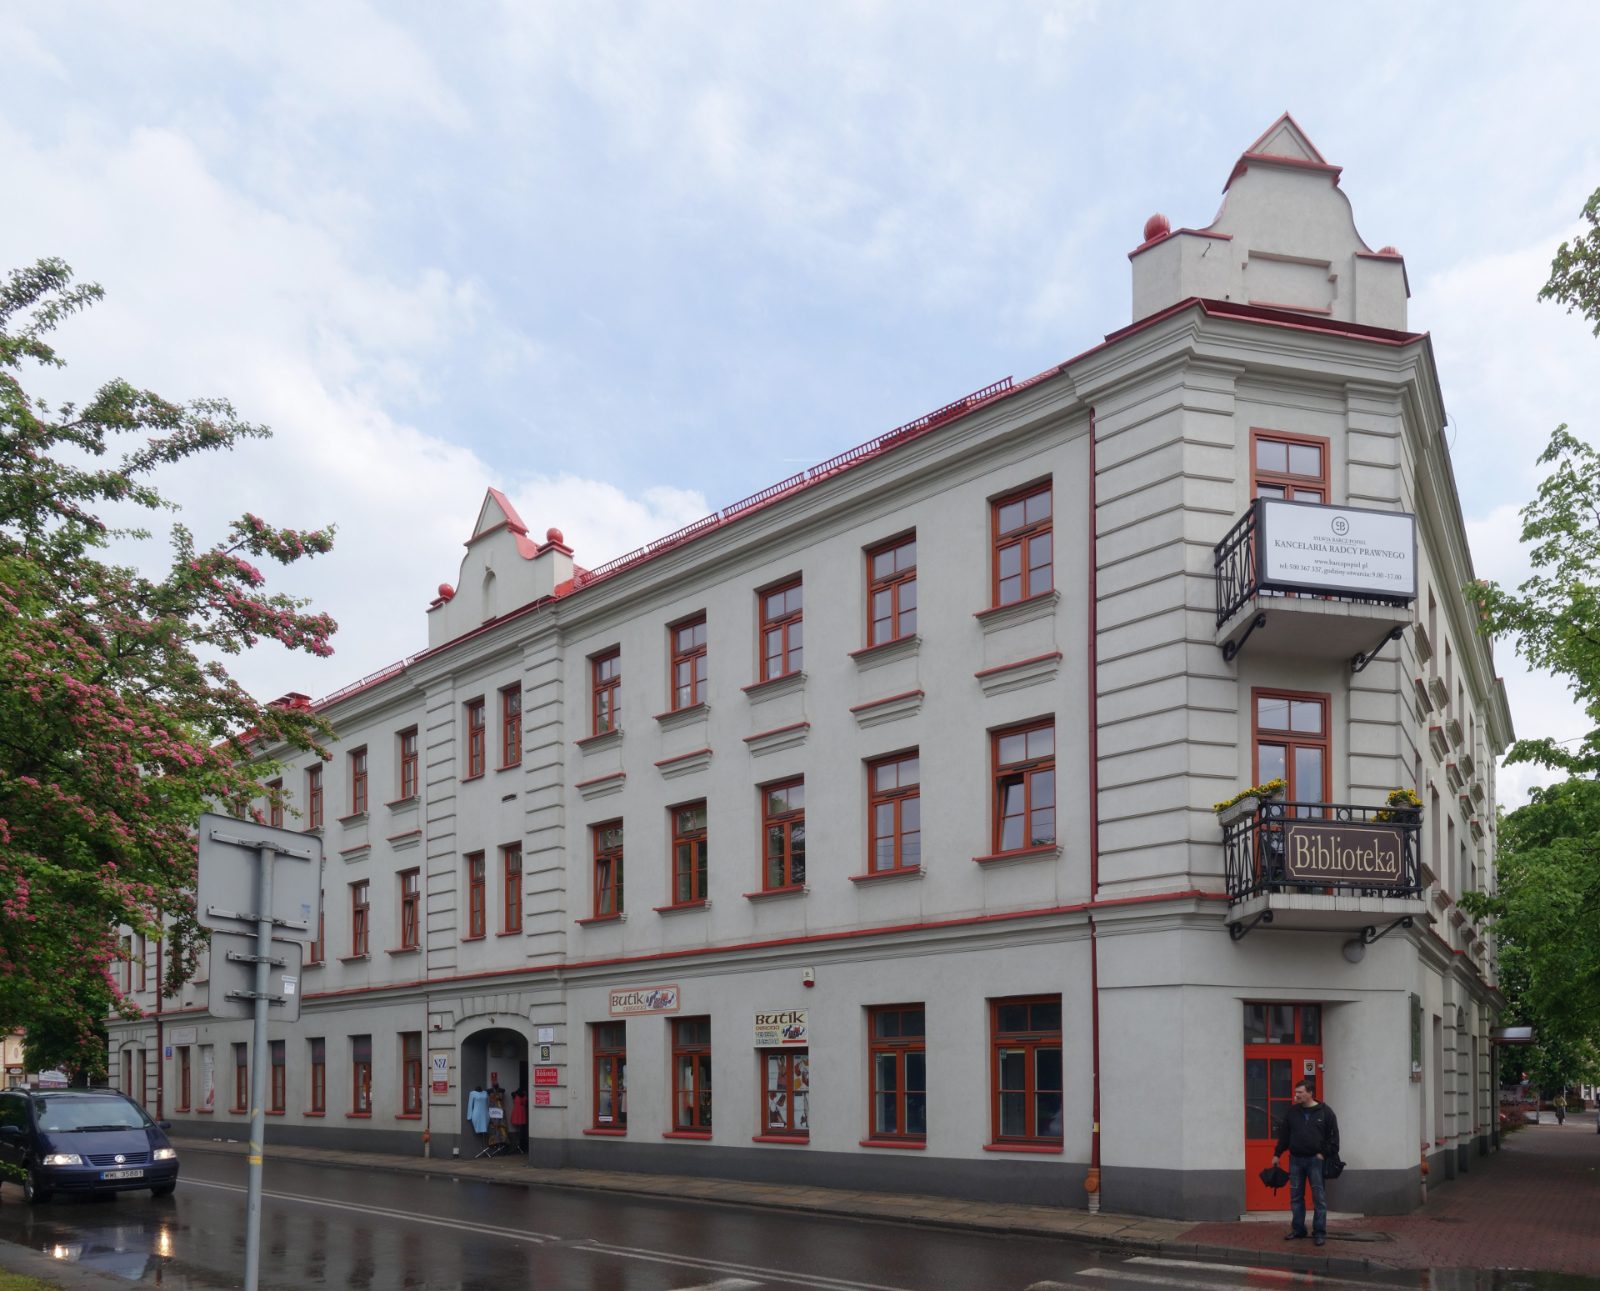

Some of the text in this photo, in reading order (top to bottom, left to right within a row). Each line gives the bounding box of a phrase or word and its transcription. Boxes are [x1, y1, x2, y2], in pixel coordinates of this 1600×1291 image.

[1275, 540, 1405, 559] KANCELARIA RADCY PRAWNEGO
[1294, 834, 1396, 873] Biblioteka
